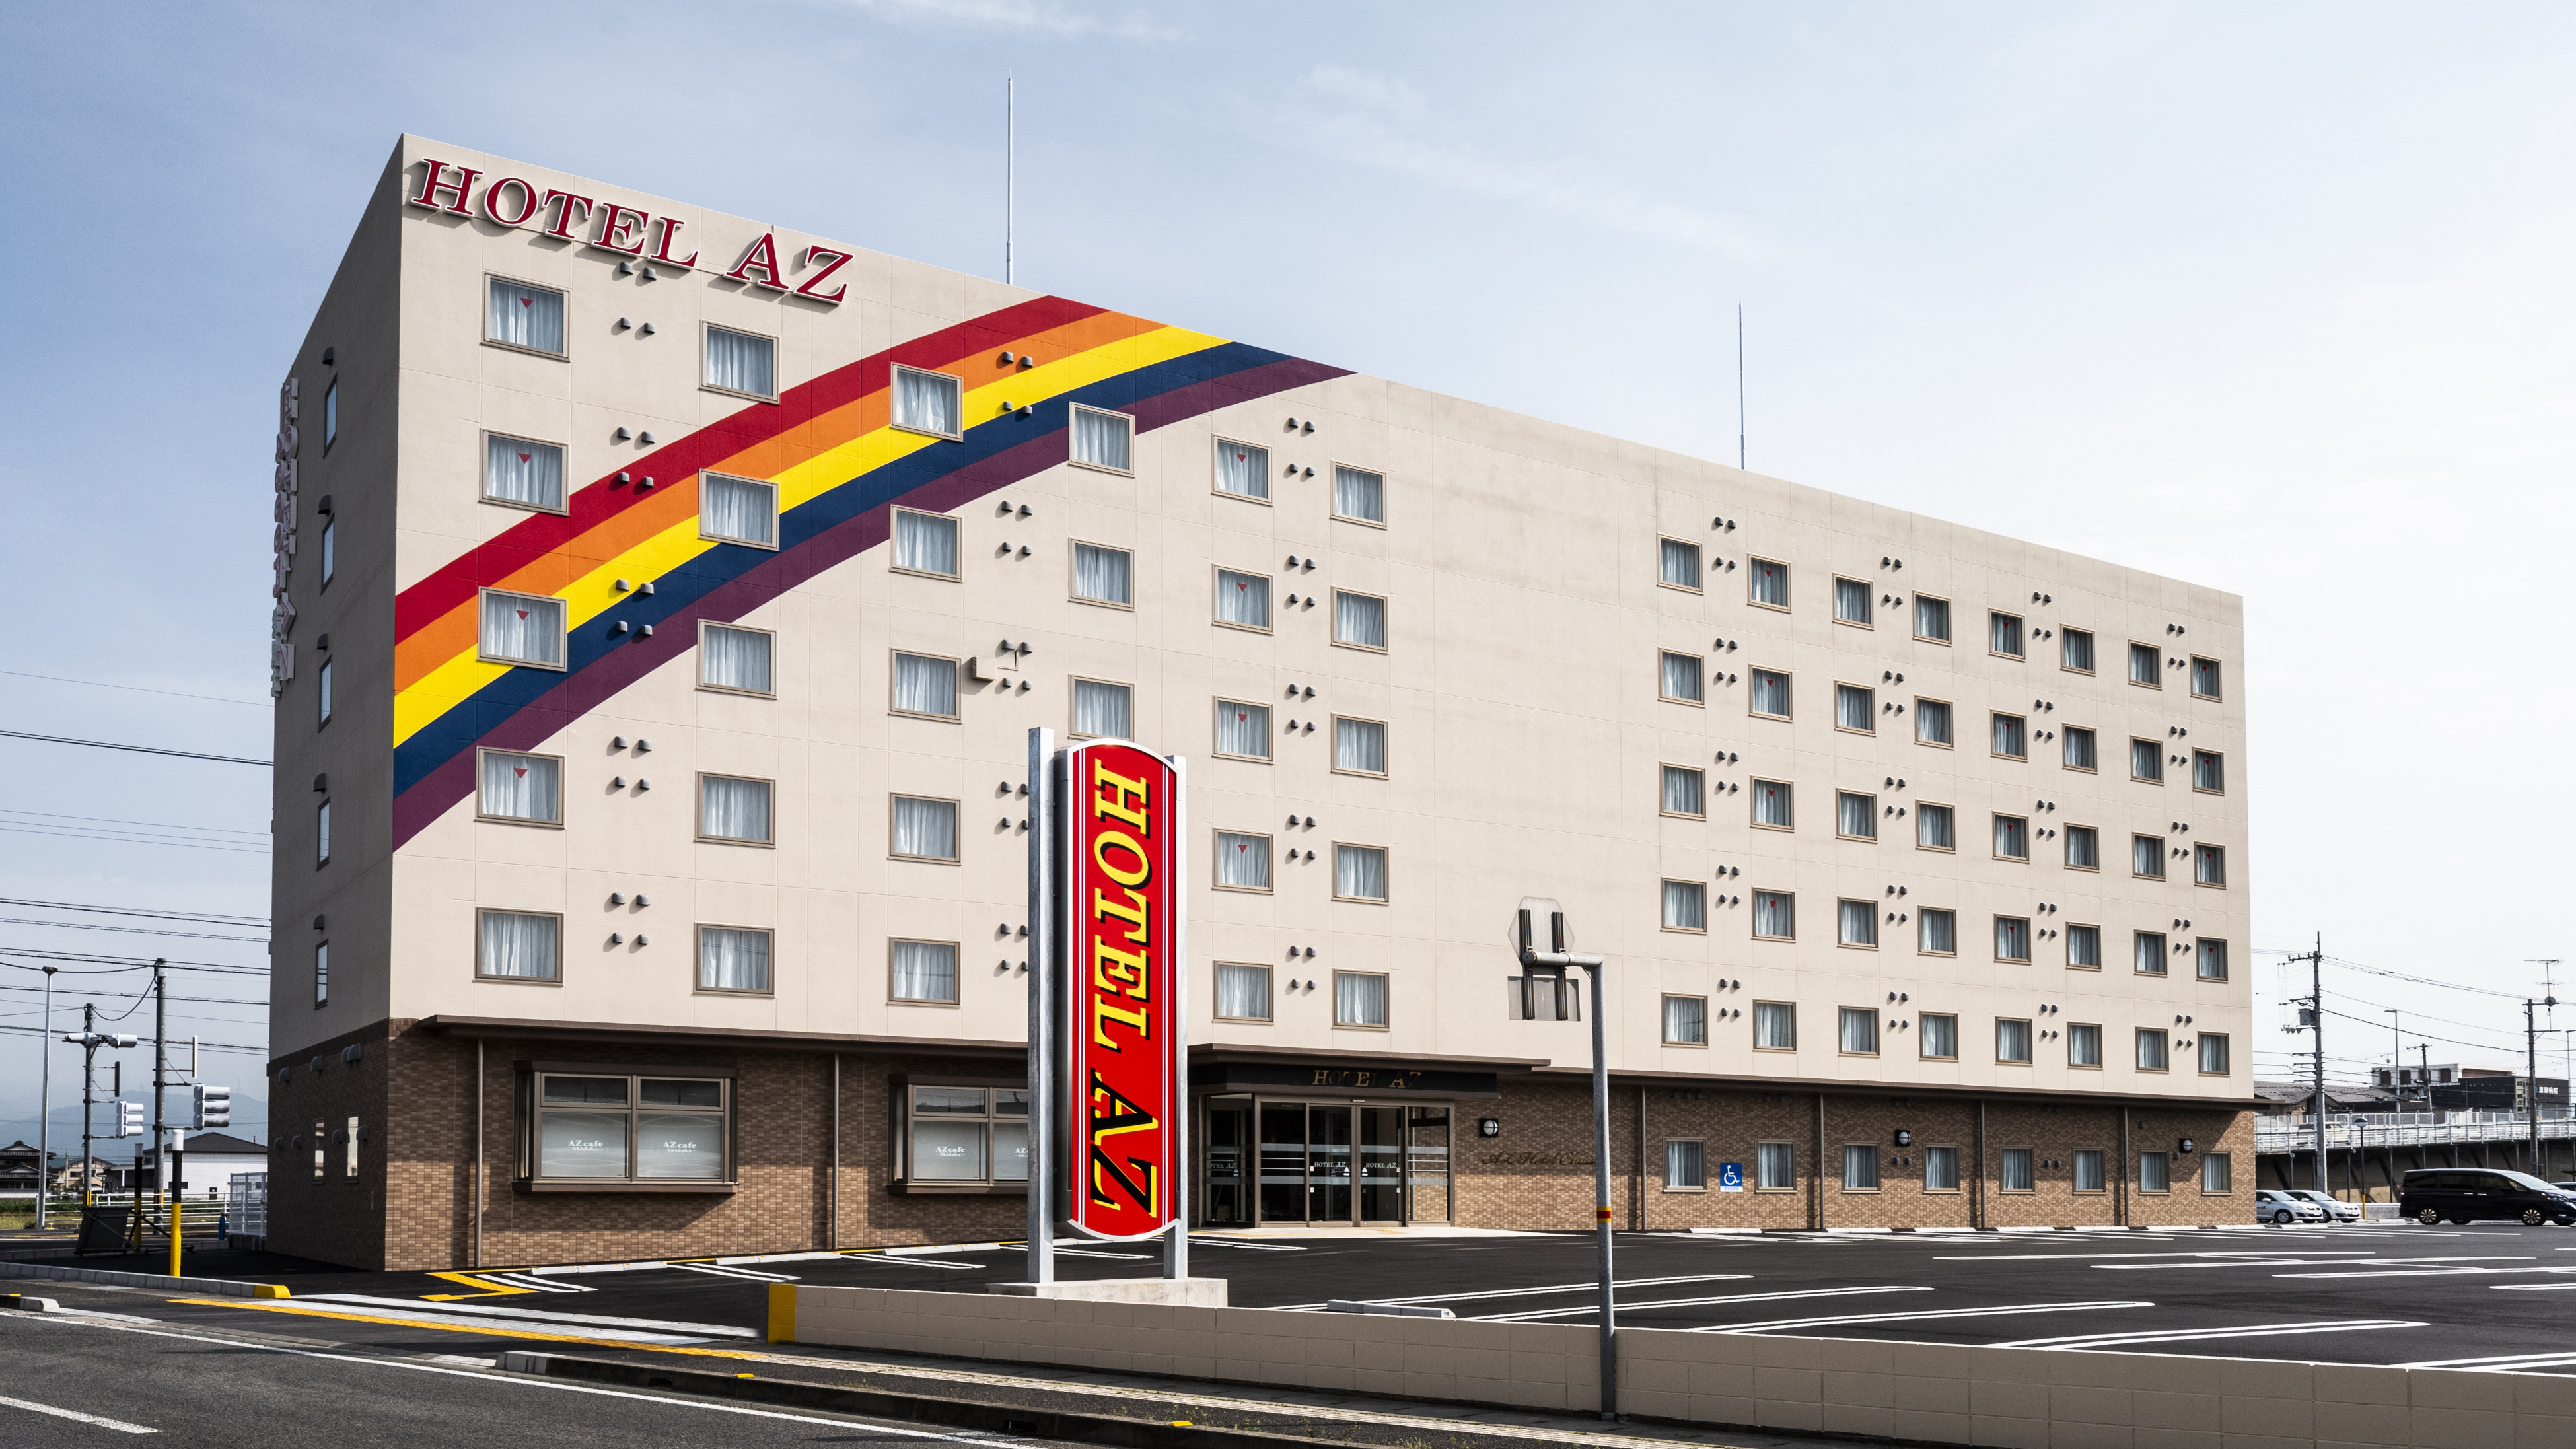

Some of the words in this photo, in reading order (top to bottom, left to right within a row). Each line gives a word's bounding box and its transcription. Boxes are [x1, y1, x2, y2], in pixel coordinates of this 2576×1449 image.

[411, 158, 699, 271] HOTEL
[723, 232, 854, 306] AZ
[1094, 758, 1151, 1053] HOTEL
[1089, 1067, 1158, 1219] AZ
[1312, 1069, 1382, 1087] HOTEL
[1388, 1070, 1422, 1088] AZ
[1517, 1151, 1561, 1165] Hotel
